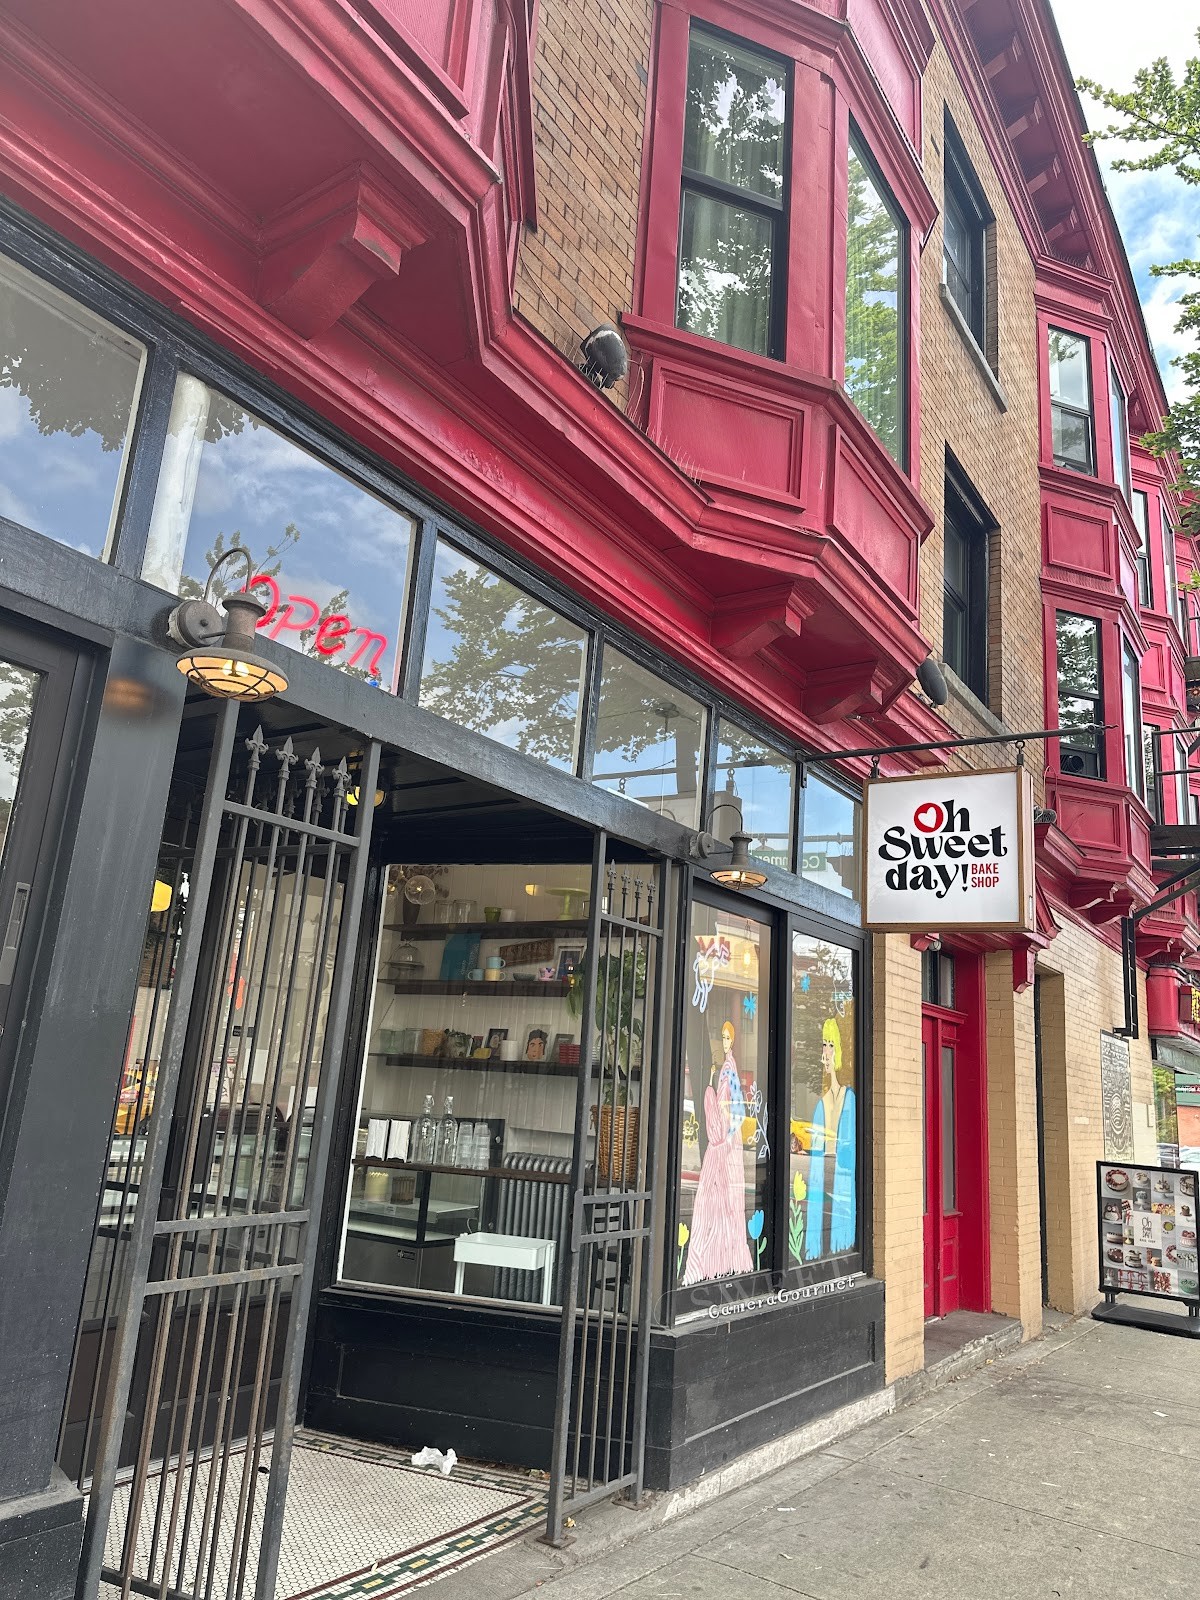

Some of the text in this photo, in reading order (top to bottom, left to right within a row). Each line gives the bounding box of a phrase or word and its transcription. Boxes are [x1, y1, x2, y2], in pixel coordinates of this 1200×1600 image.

[241, 574, 387, 676] Open
[913, 799, 970, 833] Oh
[878, 825, 1008, 860] Sweet
[885, 860, 969, 899] day!
[971, 863, 999, 875] BAKE
[971, 876, 1000, 888] SHOP
